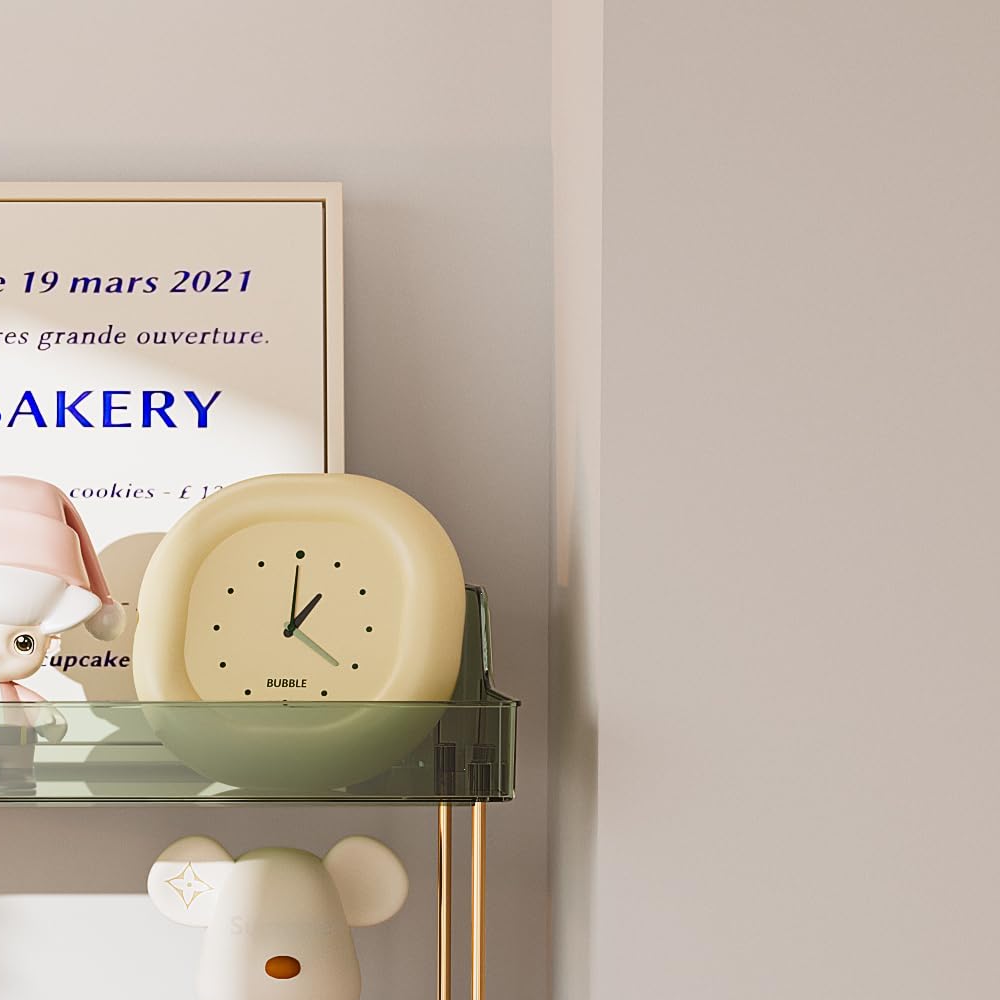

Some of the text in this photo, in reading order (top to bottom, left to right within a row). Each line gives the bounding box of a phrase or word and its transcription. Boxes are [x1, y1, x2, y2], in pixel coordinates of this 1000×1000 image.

[22, 269, 60, 294] 19
[69, 273, 159, 294] mars
[169, 269, 253, 294] 2021
[37, 324, 127, 351] grande
[135, 326, 270, 345] ouverture.
[68, 482, 155, 500] cookies
[266, 678, 308, 688] BUBBLE
